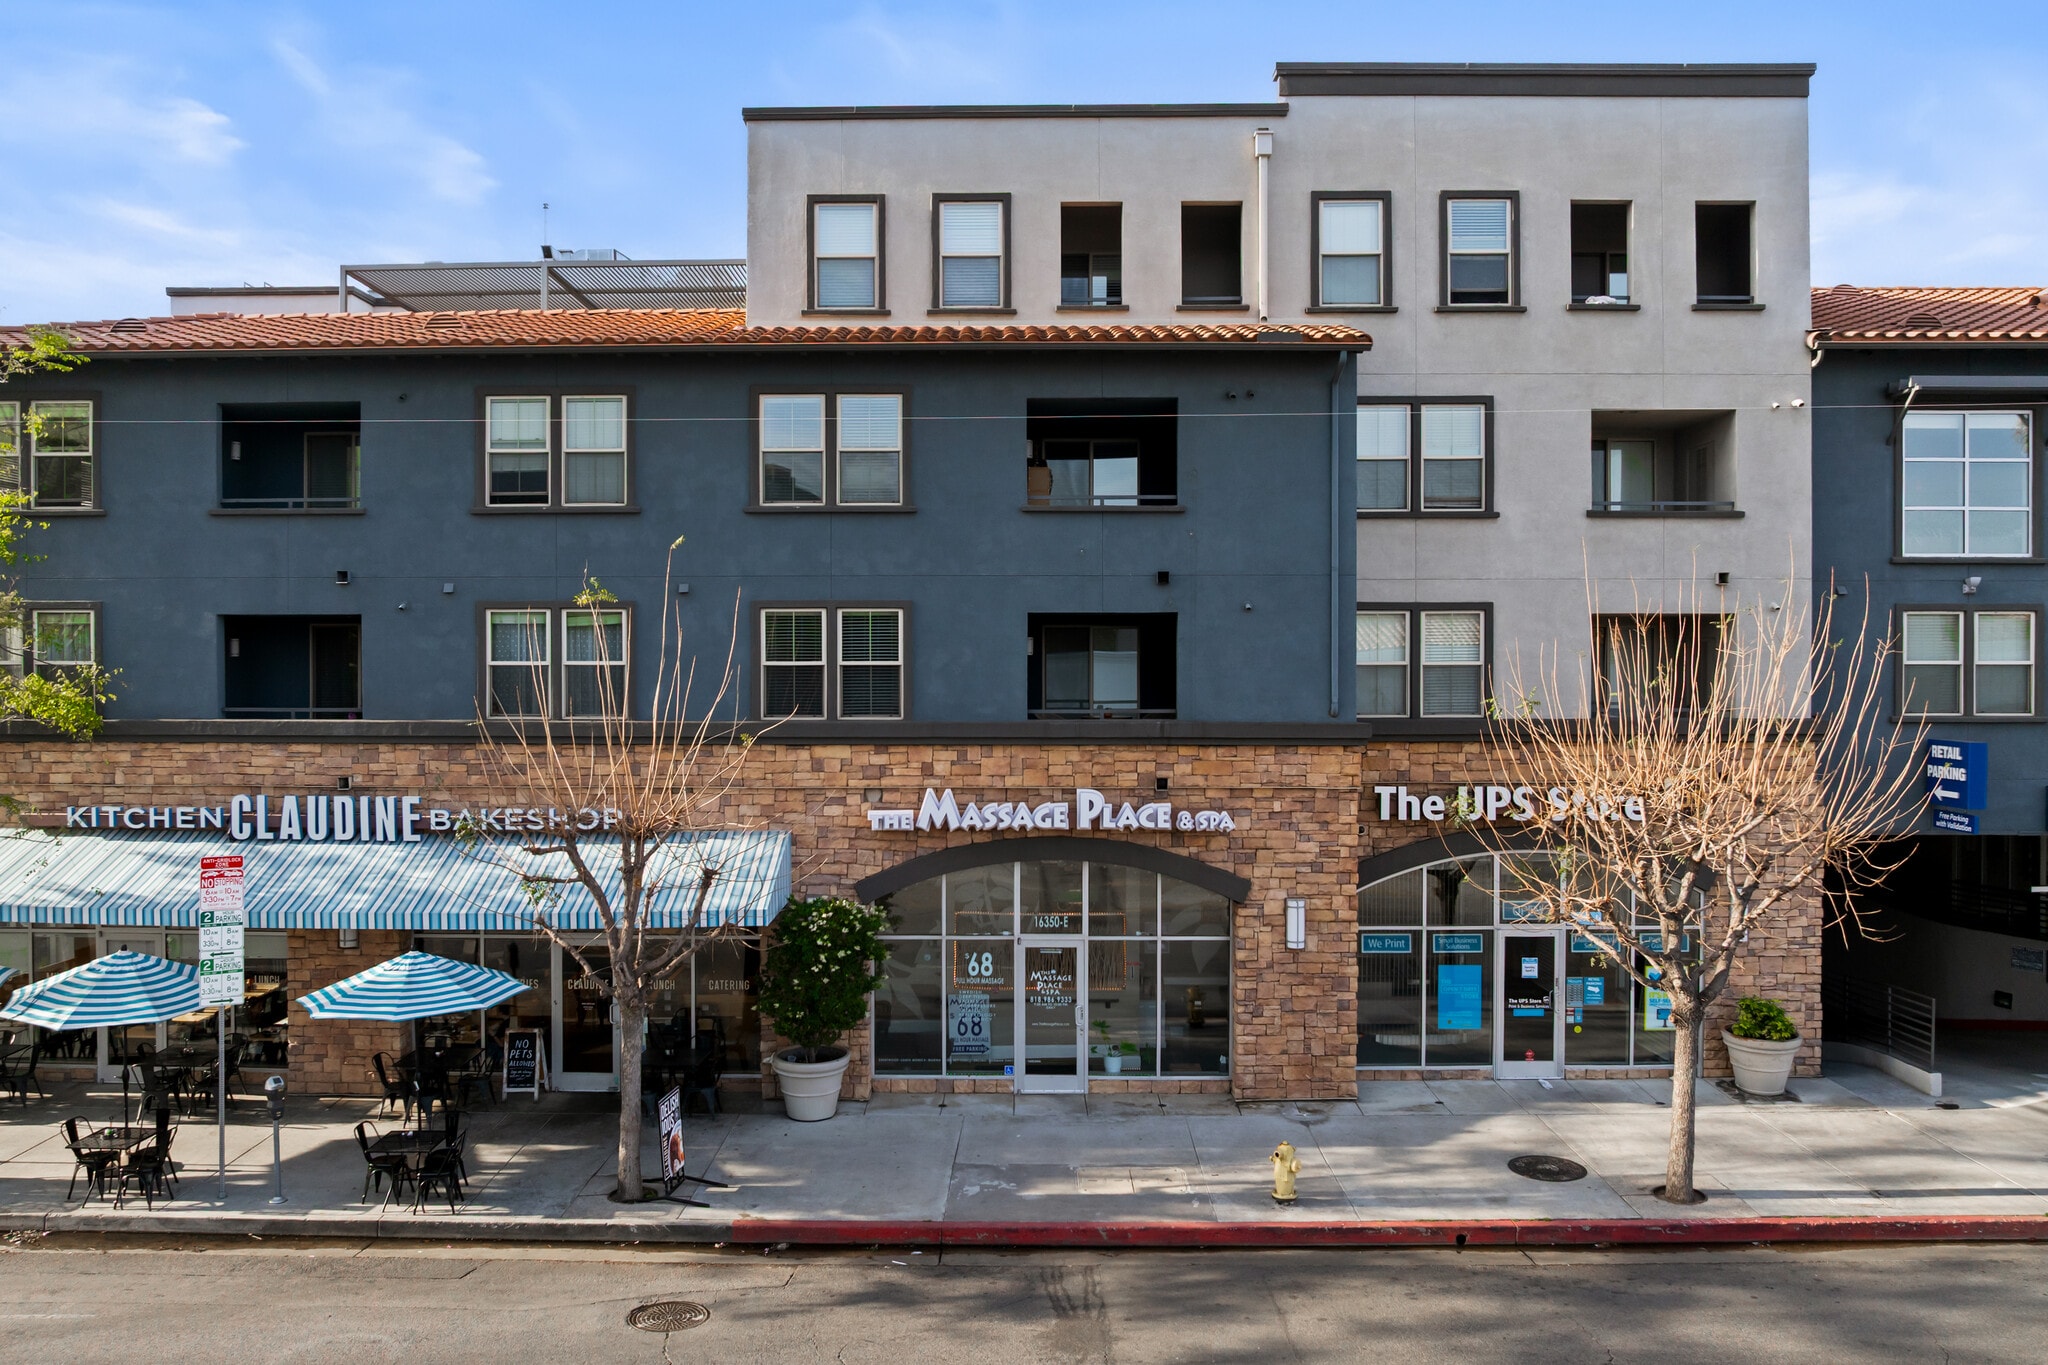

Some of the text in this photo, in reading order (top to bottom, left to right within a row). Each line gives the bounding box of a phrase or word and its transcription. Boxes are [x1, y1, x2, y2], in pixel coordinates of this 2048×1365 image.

[1931, 745, 1963, 760] RETAIL
[1927, 764, 1967, 781] PARKING
[1374, 786, 1445, 821] The
[1453, 786, 1534, 822] UPS
[867, 809, 914, 831] THE
[917, 788, 1069, 831] MASSAGE
[1076, 788, 1172, 832] PLACE
[67, 794, 624, 843] KITCHEN CLAUDINE BAKESHOP
[1939, 811, 1969, 824] Free Parking
[1936, 820, 1972, 832] with Validation
[201, 877, 243, 888] NO STOPPING
[203, 912, 212, 923] 2
[215, 914, 242, 923] PARKING
[1034, 915, 1069, 928] 16350-E
[1368, 938, 1405, 948] We Print
[1454, 936, 1478, 944] Business
[203, 960, 211, 971] 2
[215, 961, 242, 970] PARKING
[254, 975, 280, 983] LUNCH
[1030, 970, 1072, 982] MASSAGE
[567, 978, 609, 990] CLAUDIE
[708, 979, 750, 990] CATERING
[1037, 981, 1062, 991] PLACE
[515, 1039, 530, 1049] NO
[509, 1049, 533, 1059] PETS
